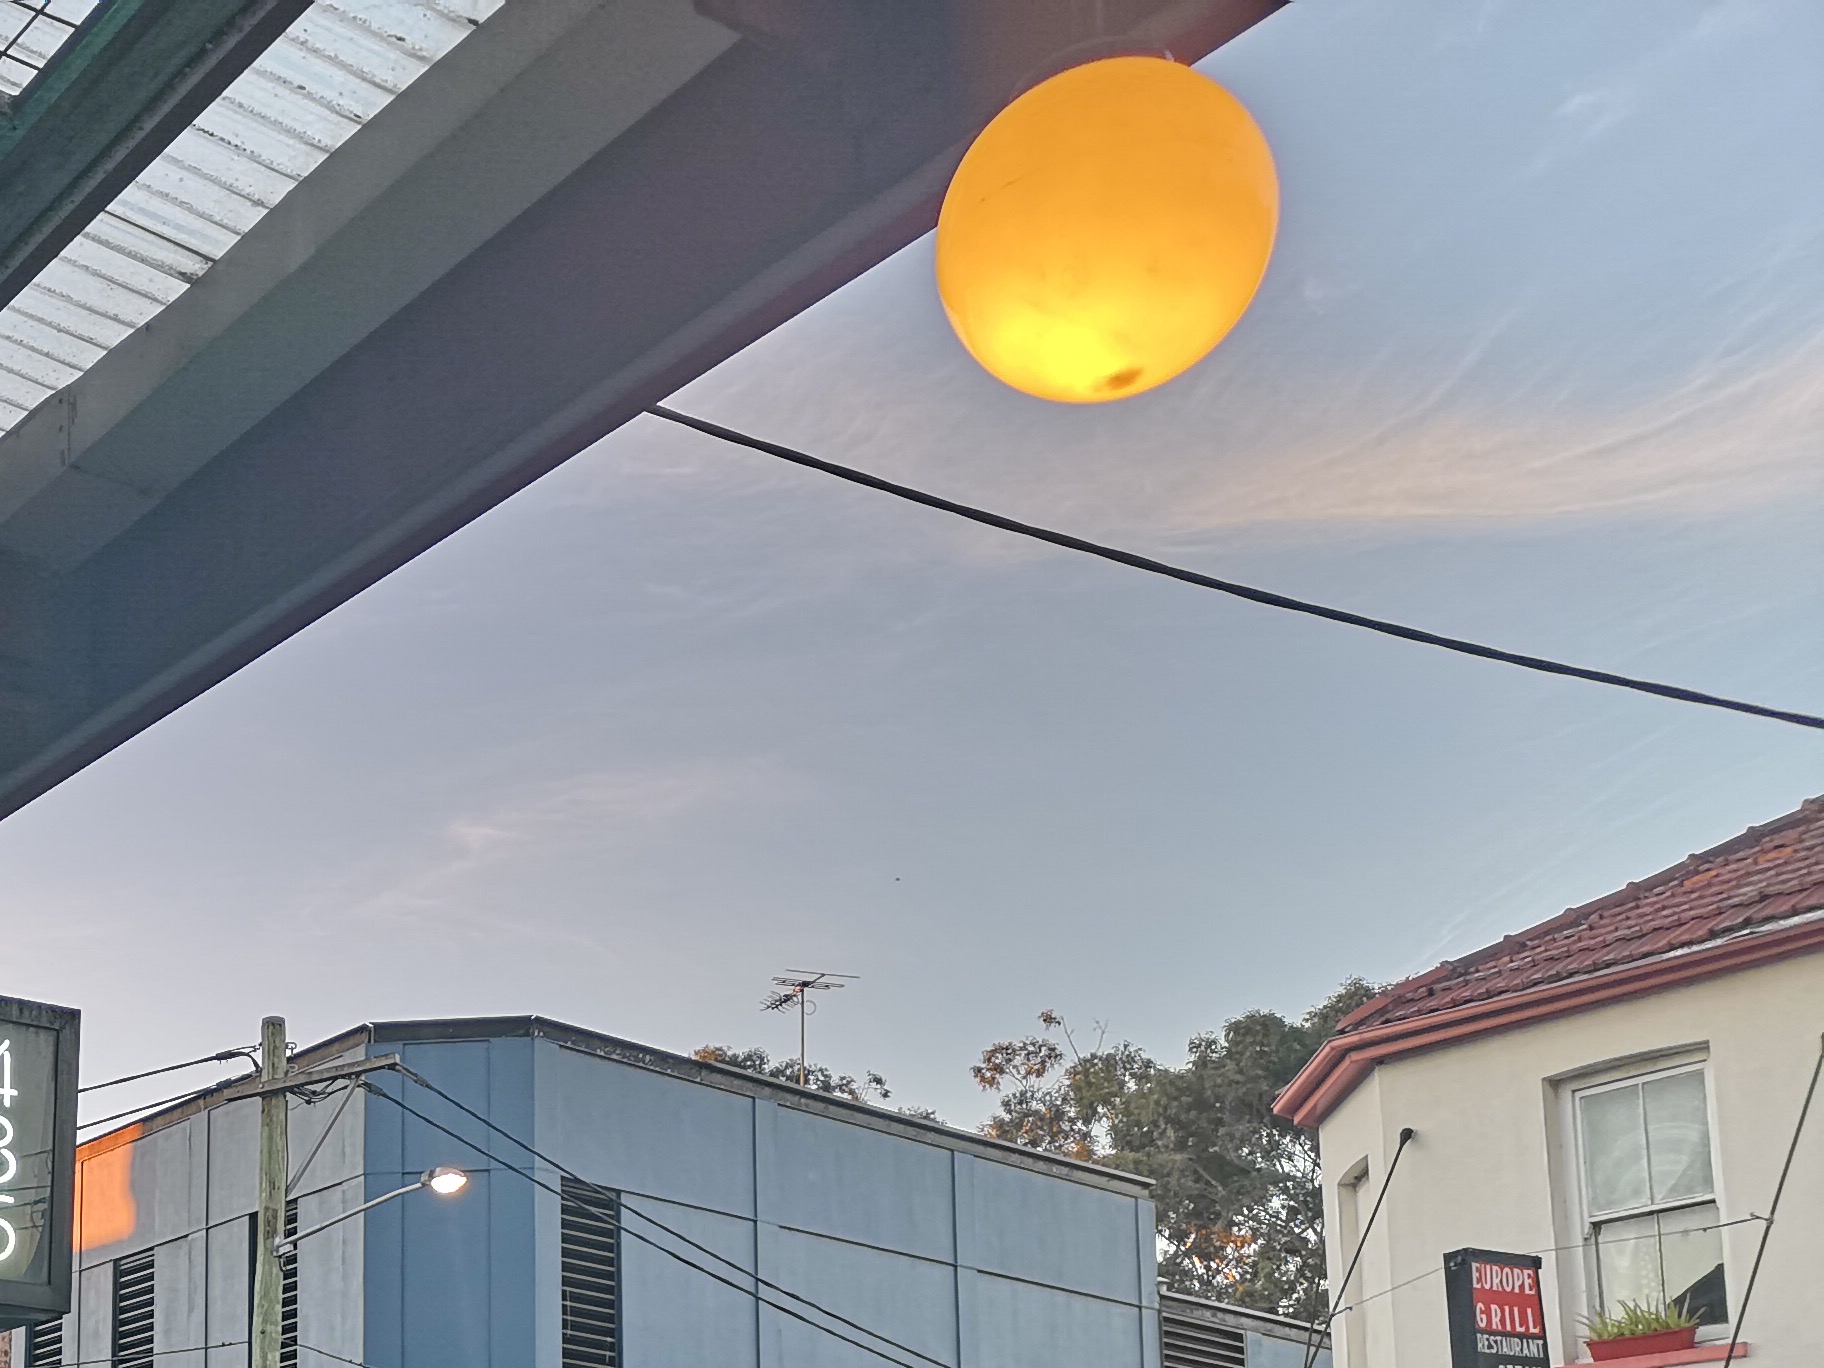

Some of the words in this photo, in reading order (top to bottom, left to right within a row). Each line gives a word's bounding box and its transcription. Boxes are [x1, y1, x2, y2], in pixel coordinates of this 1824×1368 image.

[1471, 1261, 1536, 1295] EUROPE
[1476, 1302, 1540, 1334] GRILL
[1477, 1333, 1544, 1358] RESTAURANT
